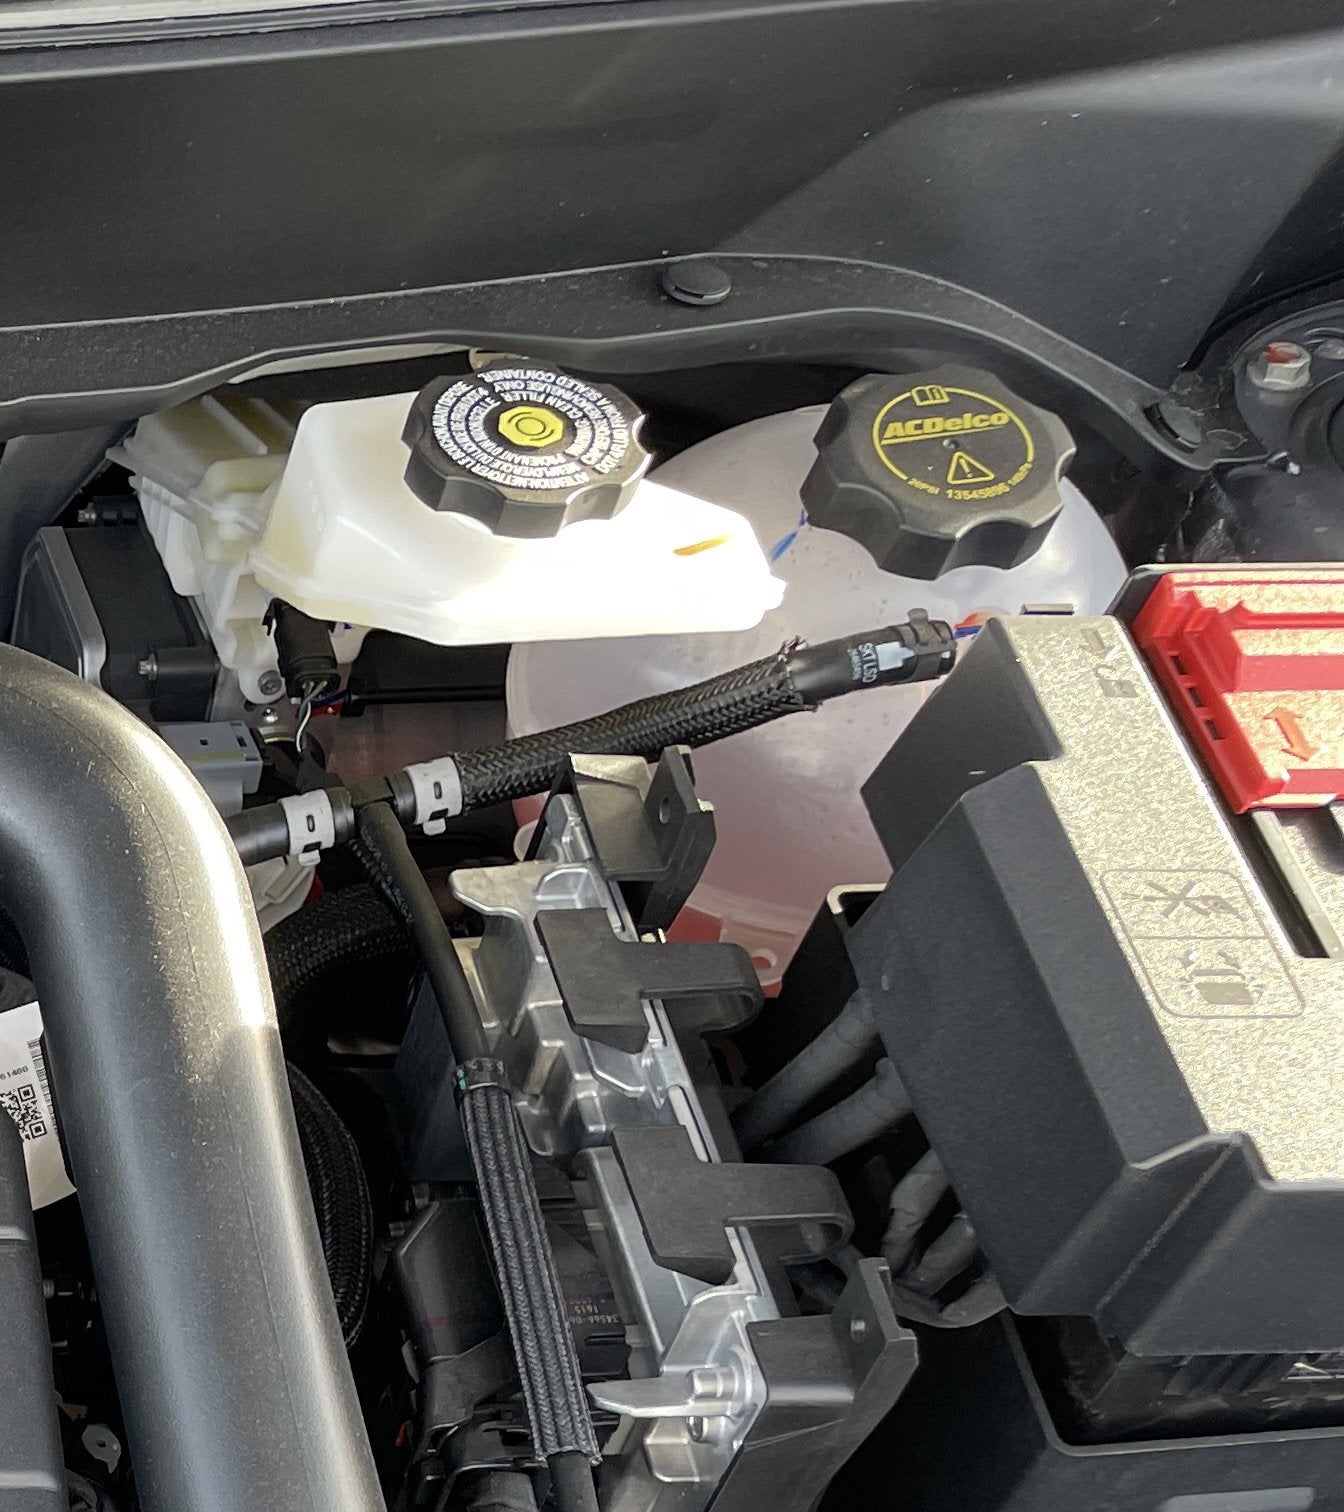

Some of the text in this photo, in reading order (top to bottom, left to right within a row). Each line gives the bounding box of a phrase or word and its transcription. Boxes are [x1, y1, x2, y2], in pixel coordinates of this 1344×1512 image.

[490, 381, 526, 395] ONLY
[554, 373, 606, 401] SEALED
[500, 391, 545, 405] FILLER
[543, 394, 585, 419] CLEAN
[600, 402, 629, 427] FROM
[884, 412, 1010, 439] ACDelco
[454, 455, 477, 470] LE
[472, 451, 494, 465] DU
[486, 458, 514, 474] QUE
[467, 463, 527, 489] NETTOYER
